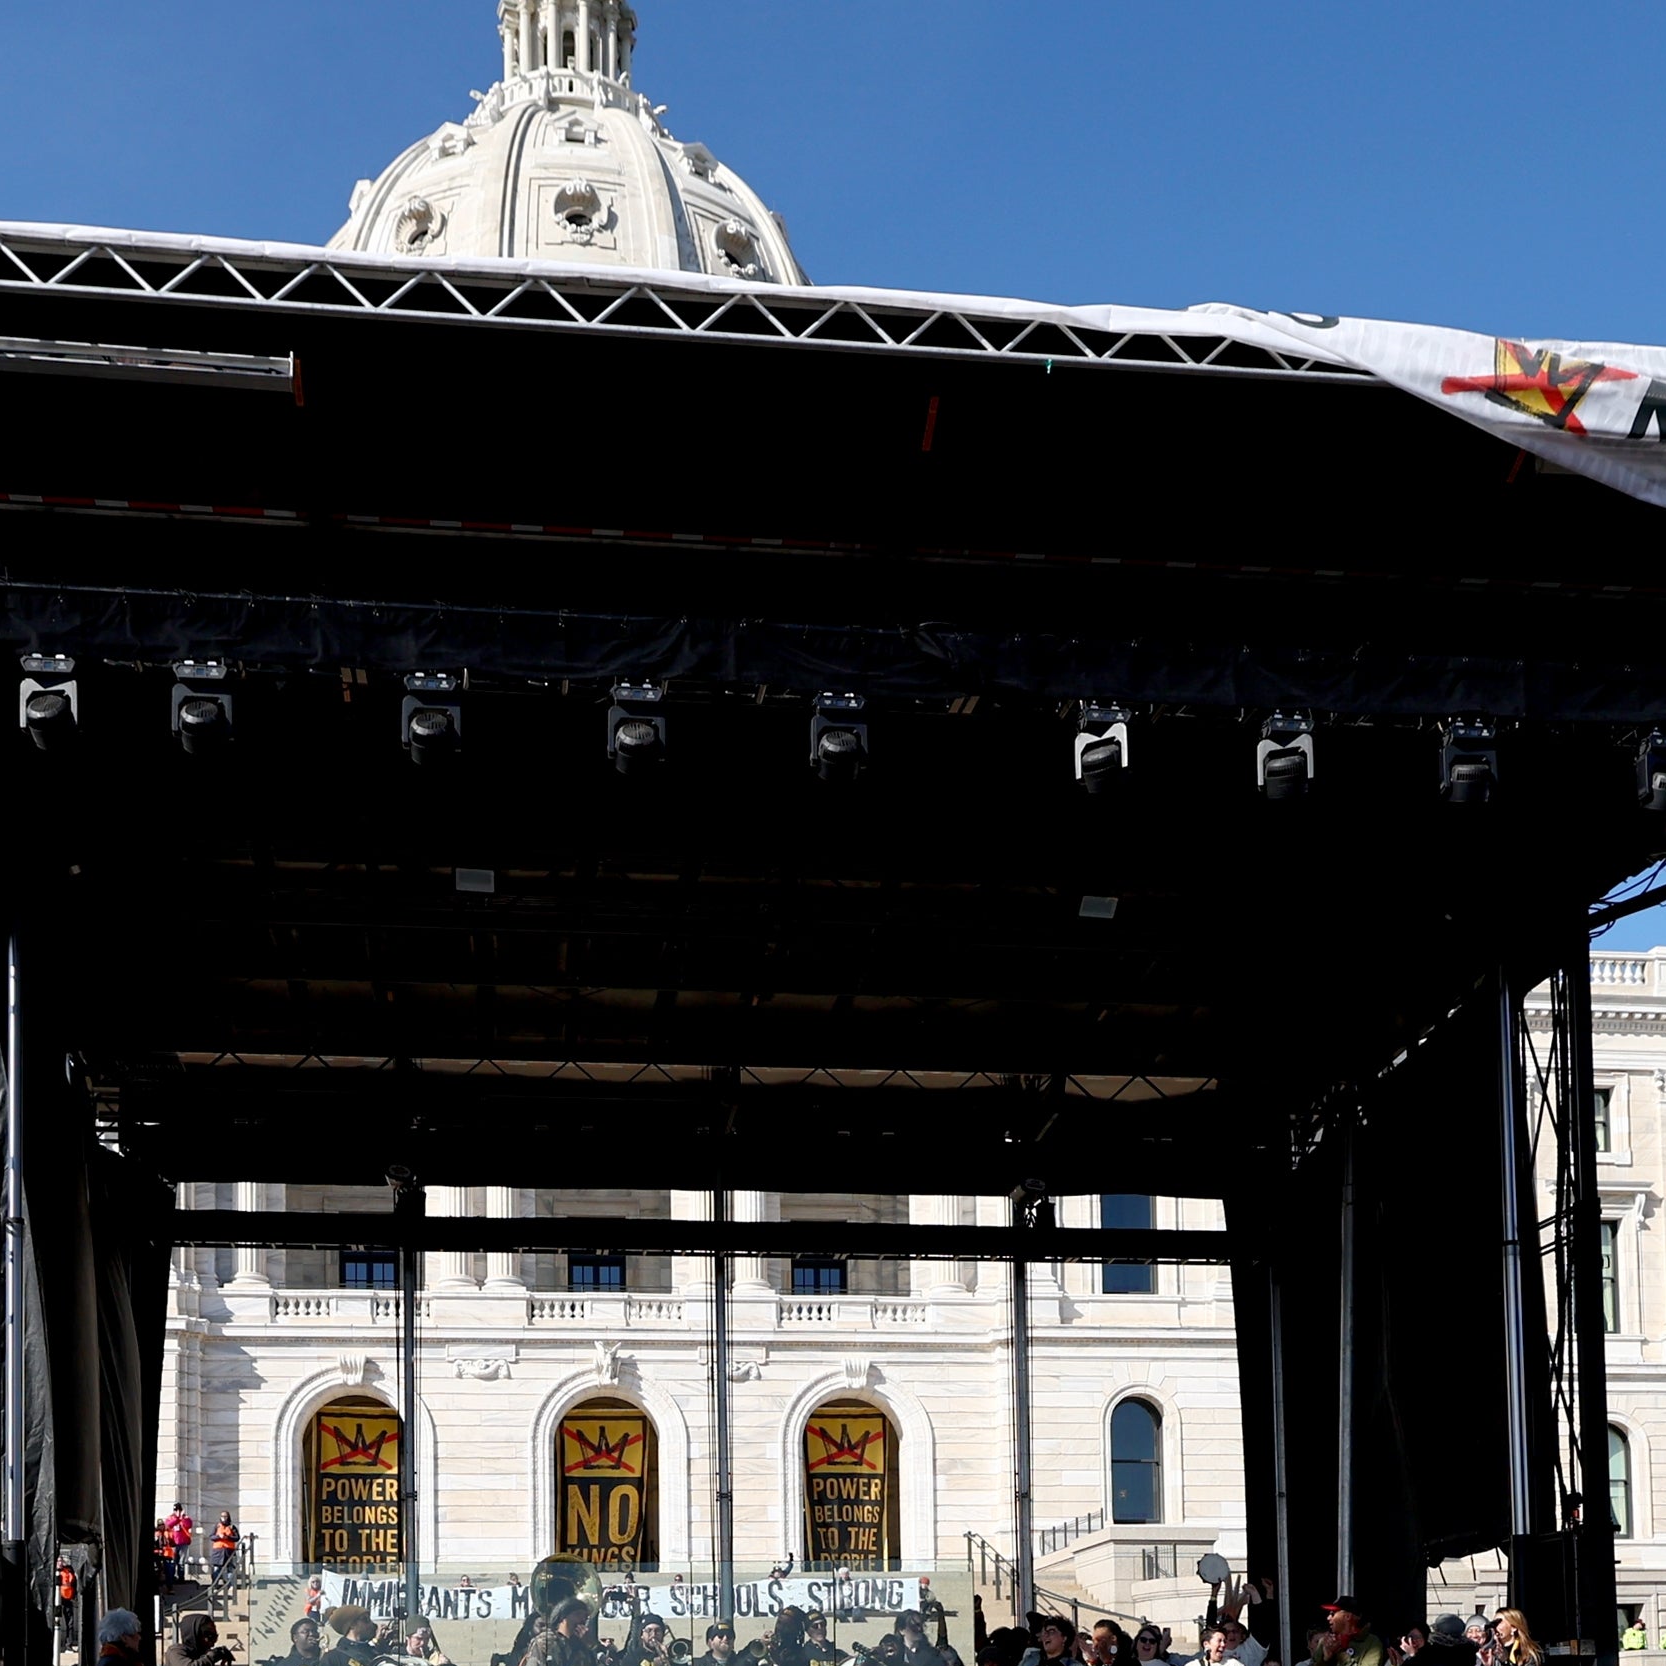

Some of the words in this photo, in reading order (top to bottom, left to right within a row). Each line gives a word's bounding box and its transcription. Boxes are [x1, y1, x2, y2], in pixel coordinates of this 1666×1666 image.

[322, 1478, 398, 1501] POWER
[812, 1478, 881, 1500] POWER
[322, 1506, 398, 1524] BELONGS
[567, 1485, 639, 1545] NO
[815, 1505, 879, 1523] BELONGS
[321, 1529, 348, 1552] TO
[358, 1529, 398, 1552] THE
[818, 1528, 839, 1549] TO
[848, 1528, 877, 1550] THE
[322, 1556, 397, 1573] PEOPLE
[567, 1547, 634, 1572] KINGS
[820, 1553, 876, 1570] PEOPLE
[670, 1579, 784, 1617] SCHOLS
[807, 1579, 904, 1611] STRONG
